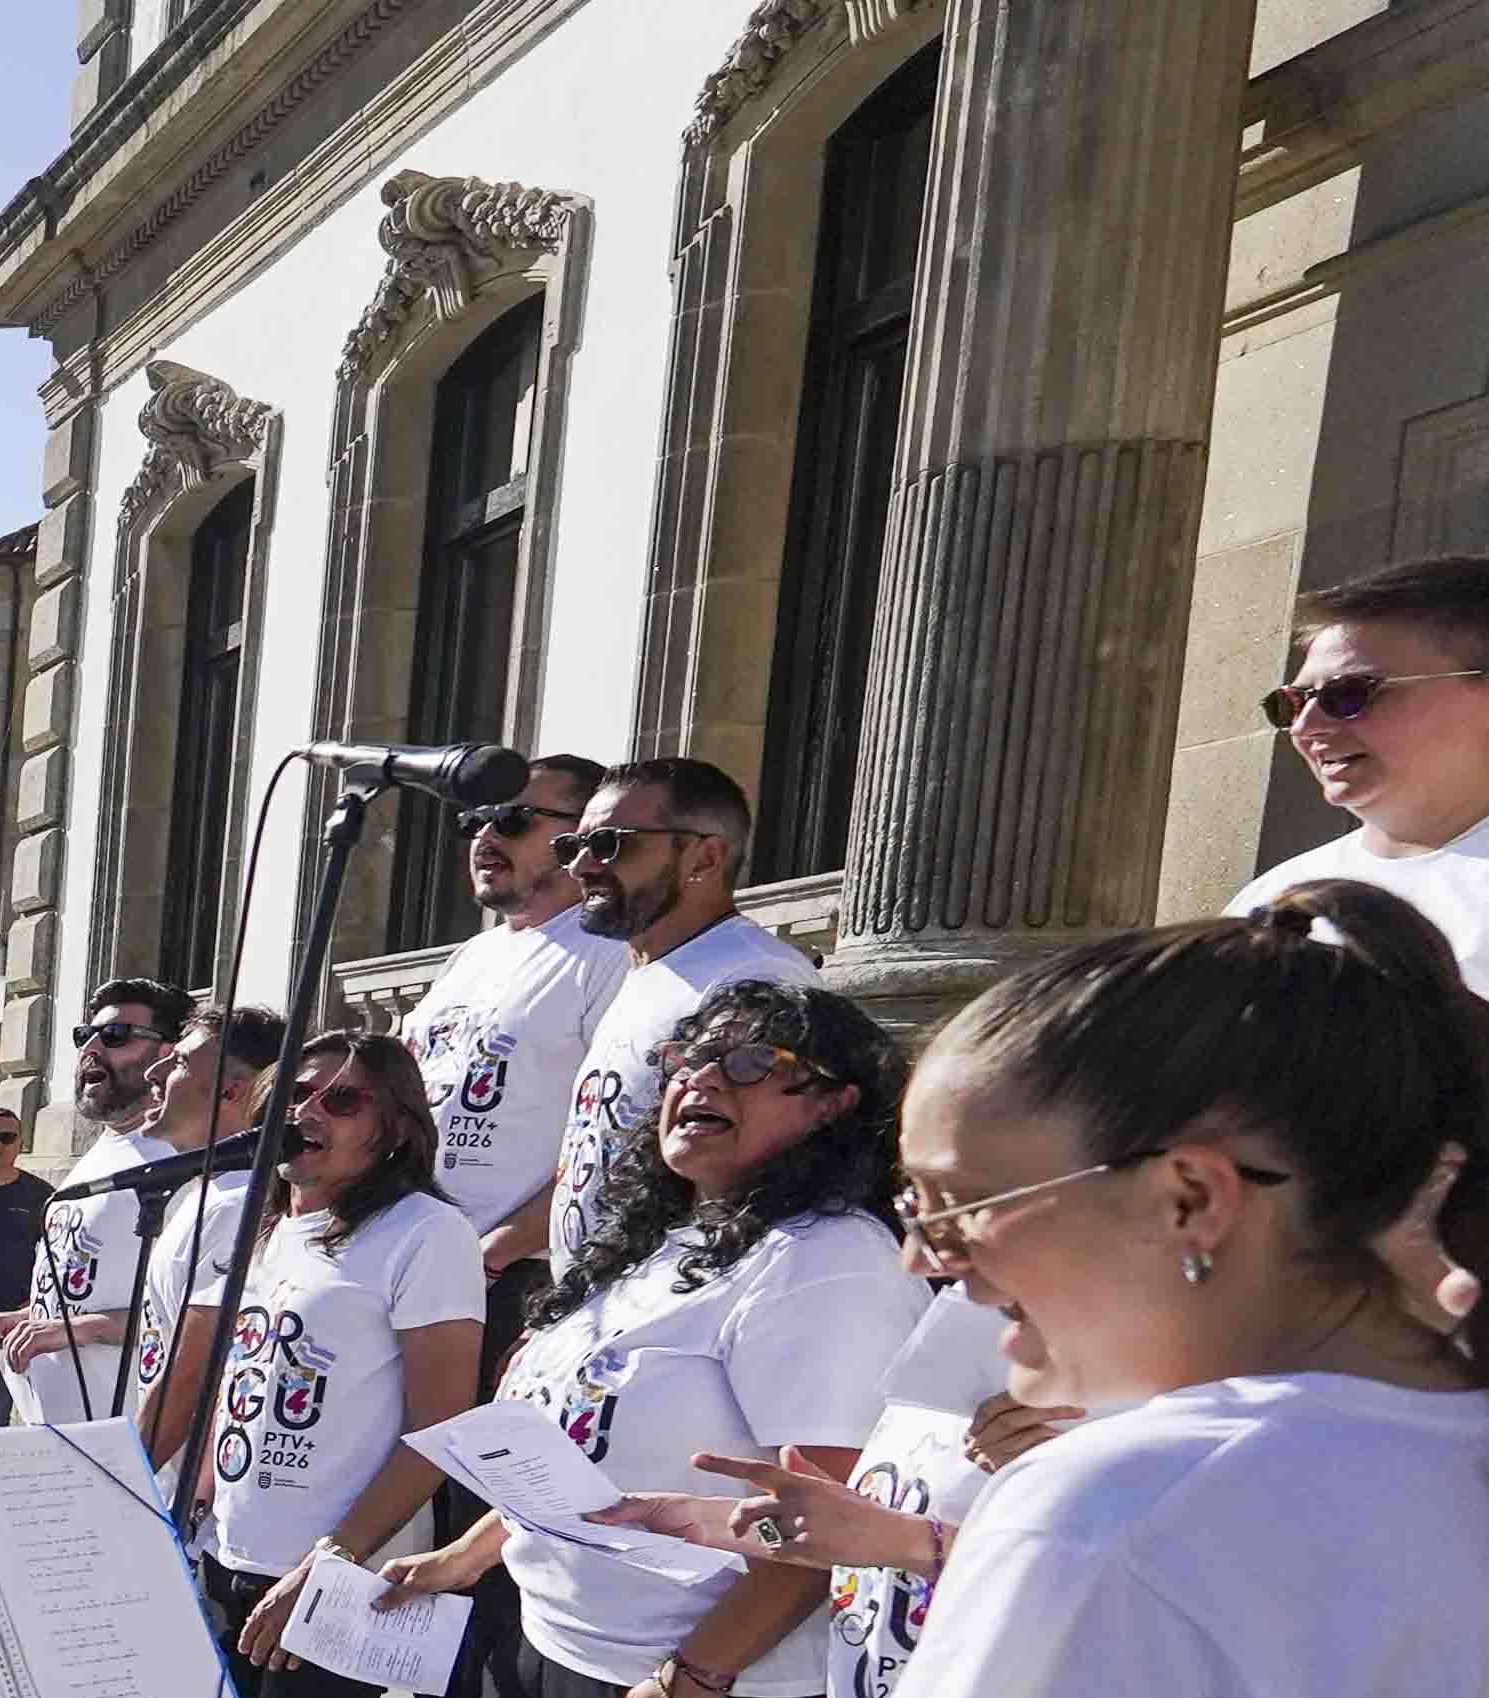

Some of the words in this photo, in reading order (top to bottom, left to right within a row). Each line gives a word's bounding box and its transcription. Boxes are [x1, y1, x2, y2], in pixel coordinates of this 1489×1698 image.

[449, 1115, 498, 1131] PTV+
[445, 1132, 493, 1148] 2026
[230, 1305, 301, 1367] OR
[227, 1367, 328, 1431] GU
[263, 1430, 317, 1451] PTV+
[259, 1449, 310, 1470] 2026
